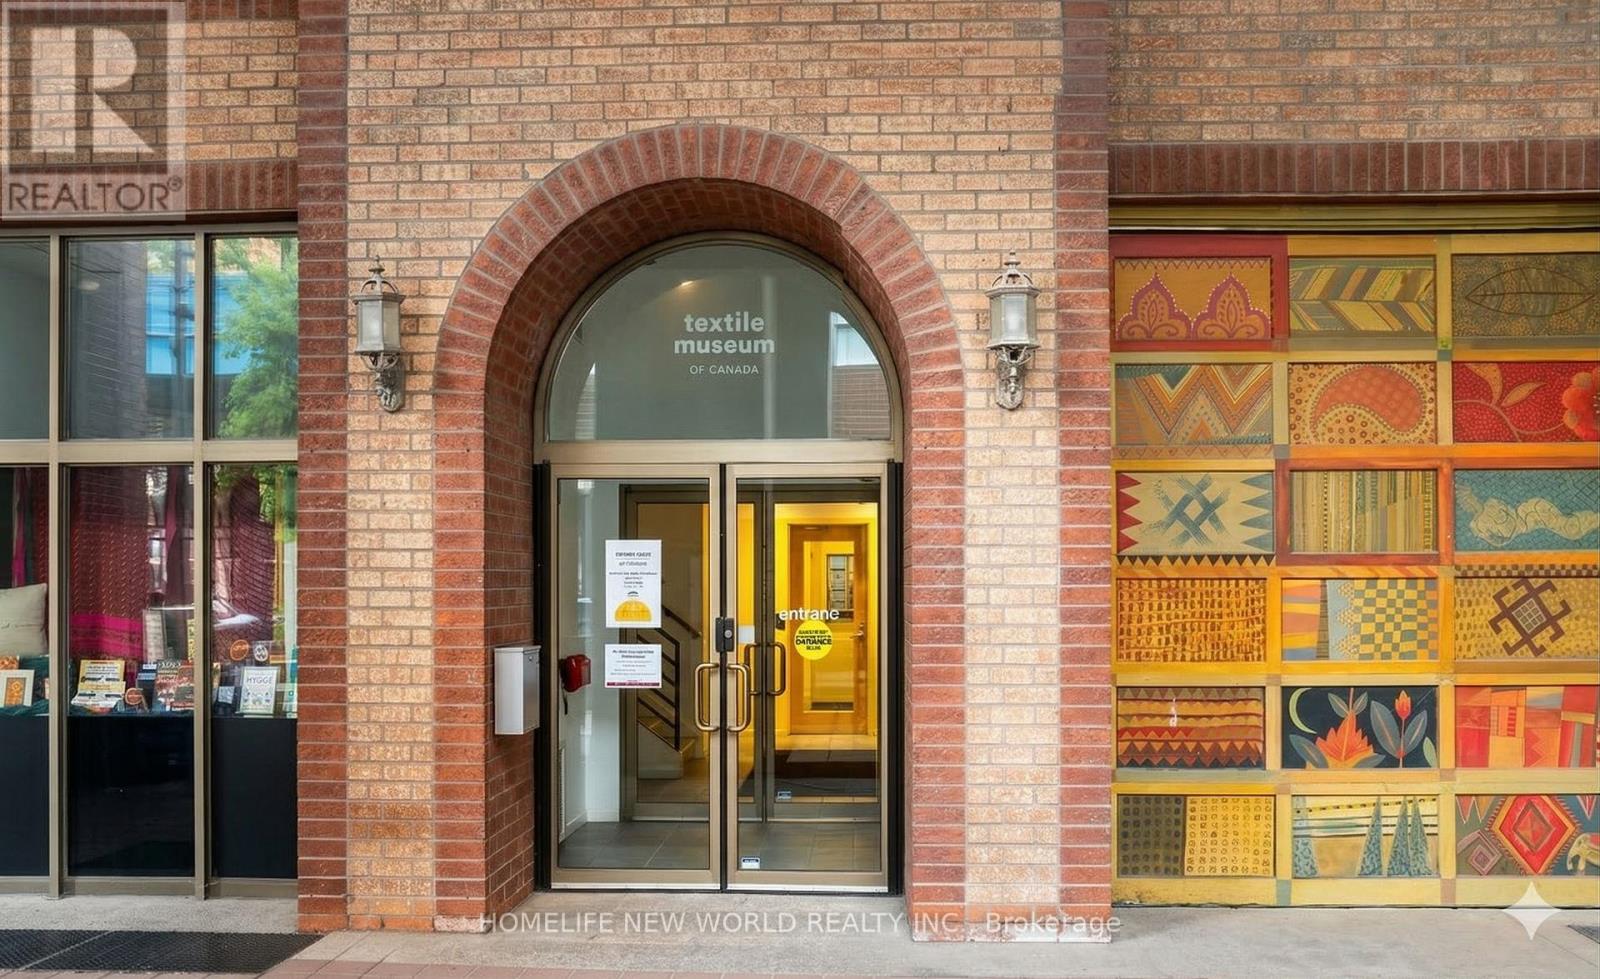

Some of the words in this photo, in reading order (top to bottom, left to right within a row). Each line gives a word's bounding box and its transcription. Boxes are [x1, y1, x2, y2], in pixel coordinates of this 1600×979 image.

[684, 311, 765, 332] textile
[674, 339, 775, 354] museum
[689, 364, 705, 374] OF
[709, 364, 760, 374] CANADA
[778, 607, 840, 620] entrane
[246, 676, 272, 684] HYGGE
